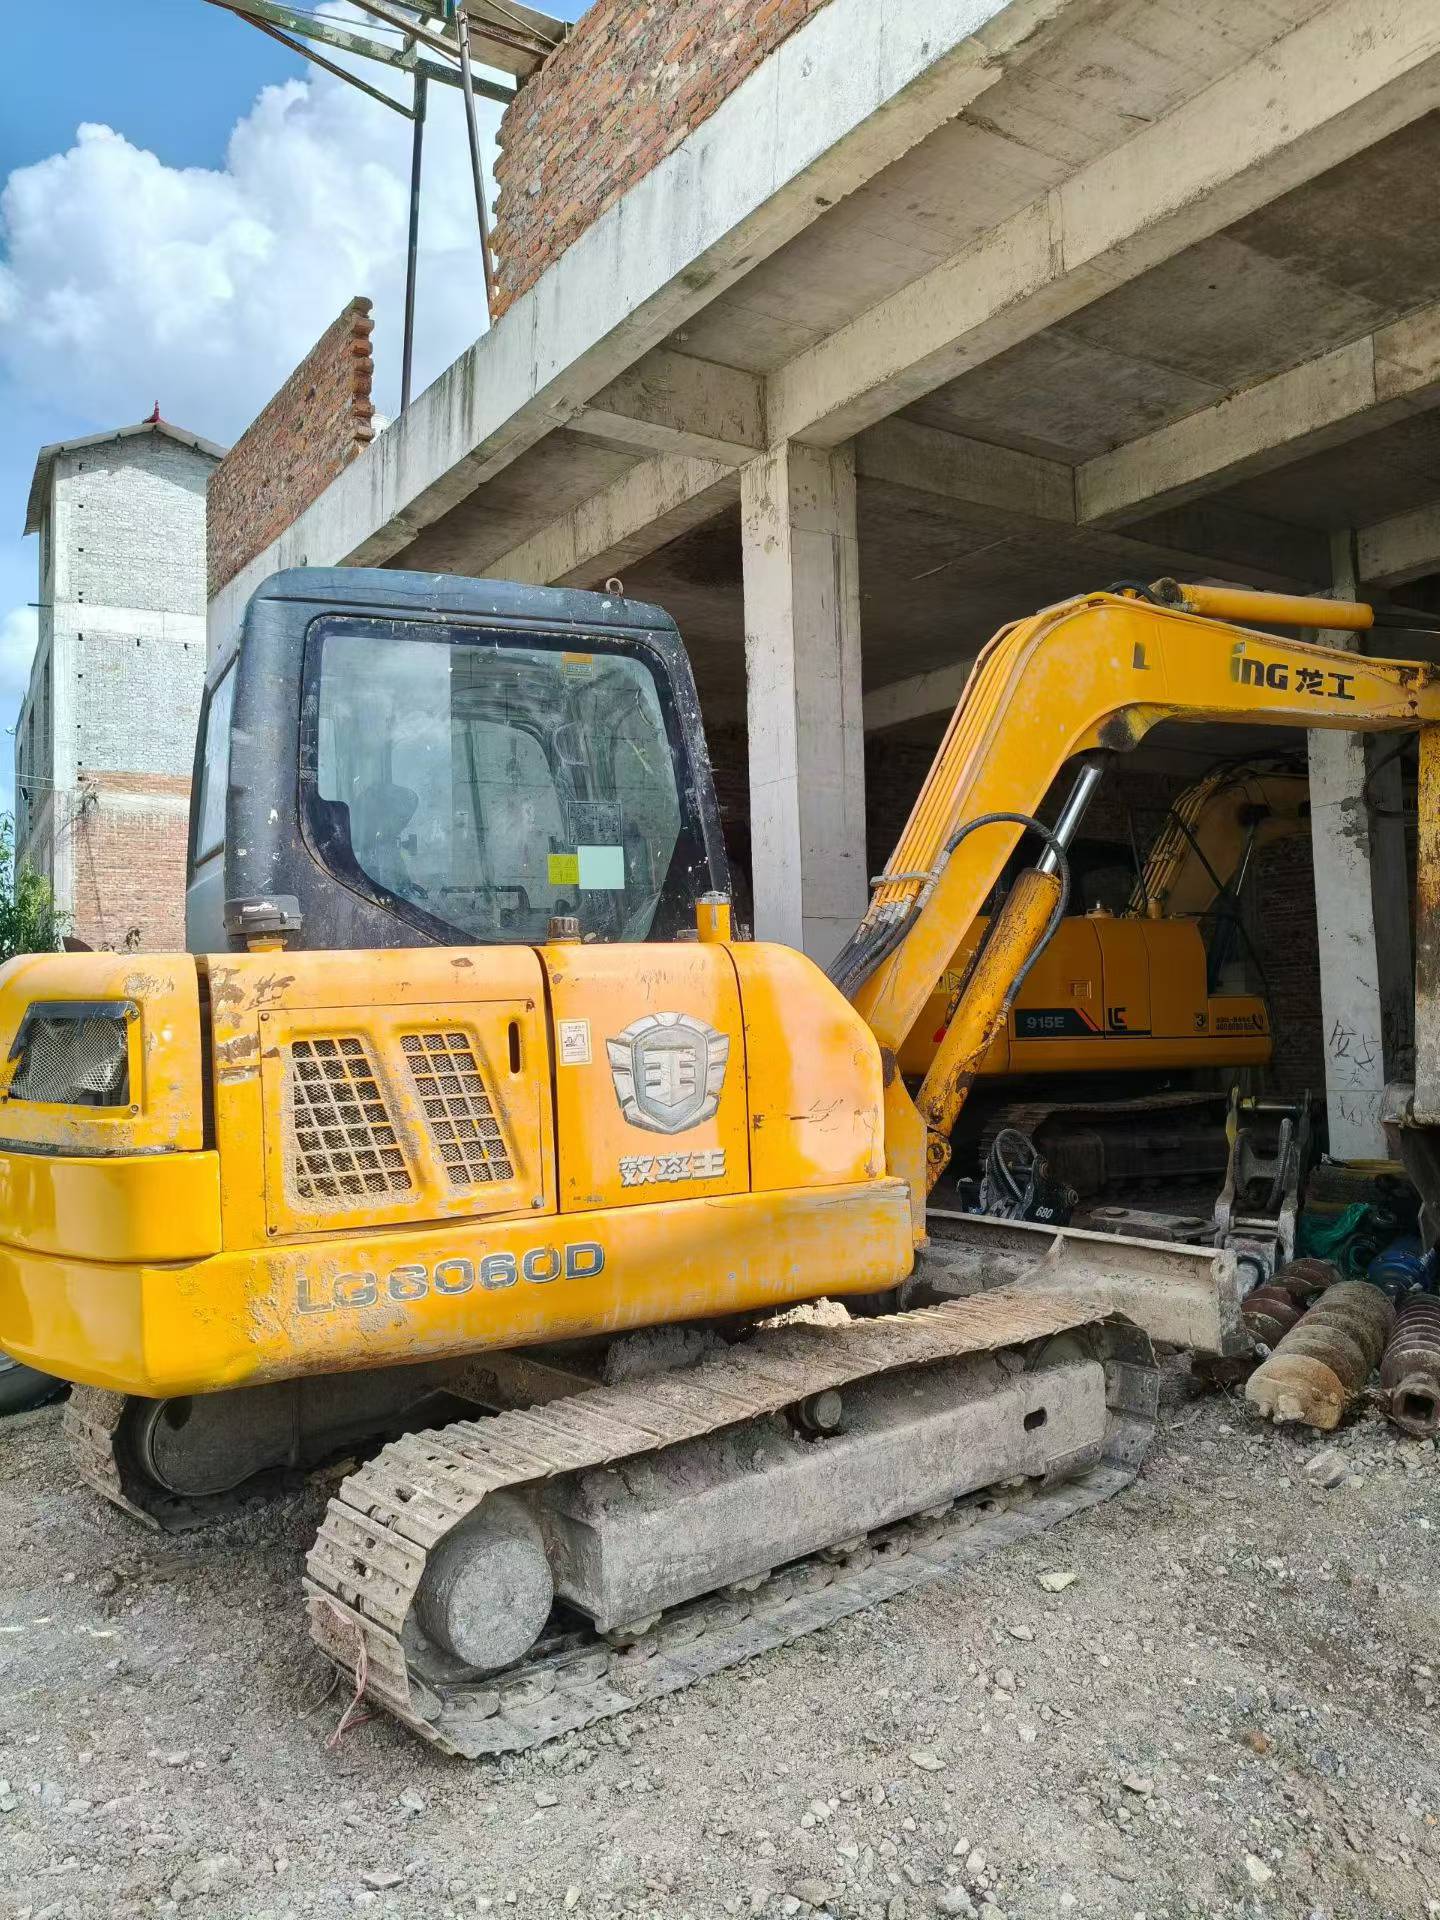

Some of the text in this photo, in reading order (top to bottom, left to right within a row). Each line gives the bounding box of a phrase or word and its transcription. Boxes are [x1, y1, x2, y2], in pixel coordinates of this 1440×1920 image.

[1295, 667, 1355, 700] 龙工
[1026, 1016, 1065, 1029] 915E
[1035, 1206, 1054, 1219] 680
[296, 1241, 605, 1314] LG6060D
